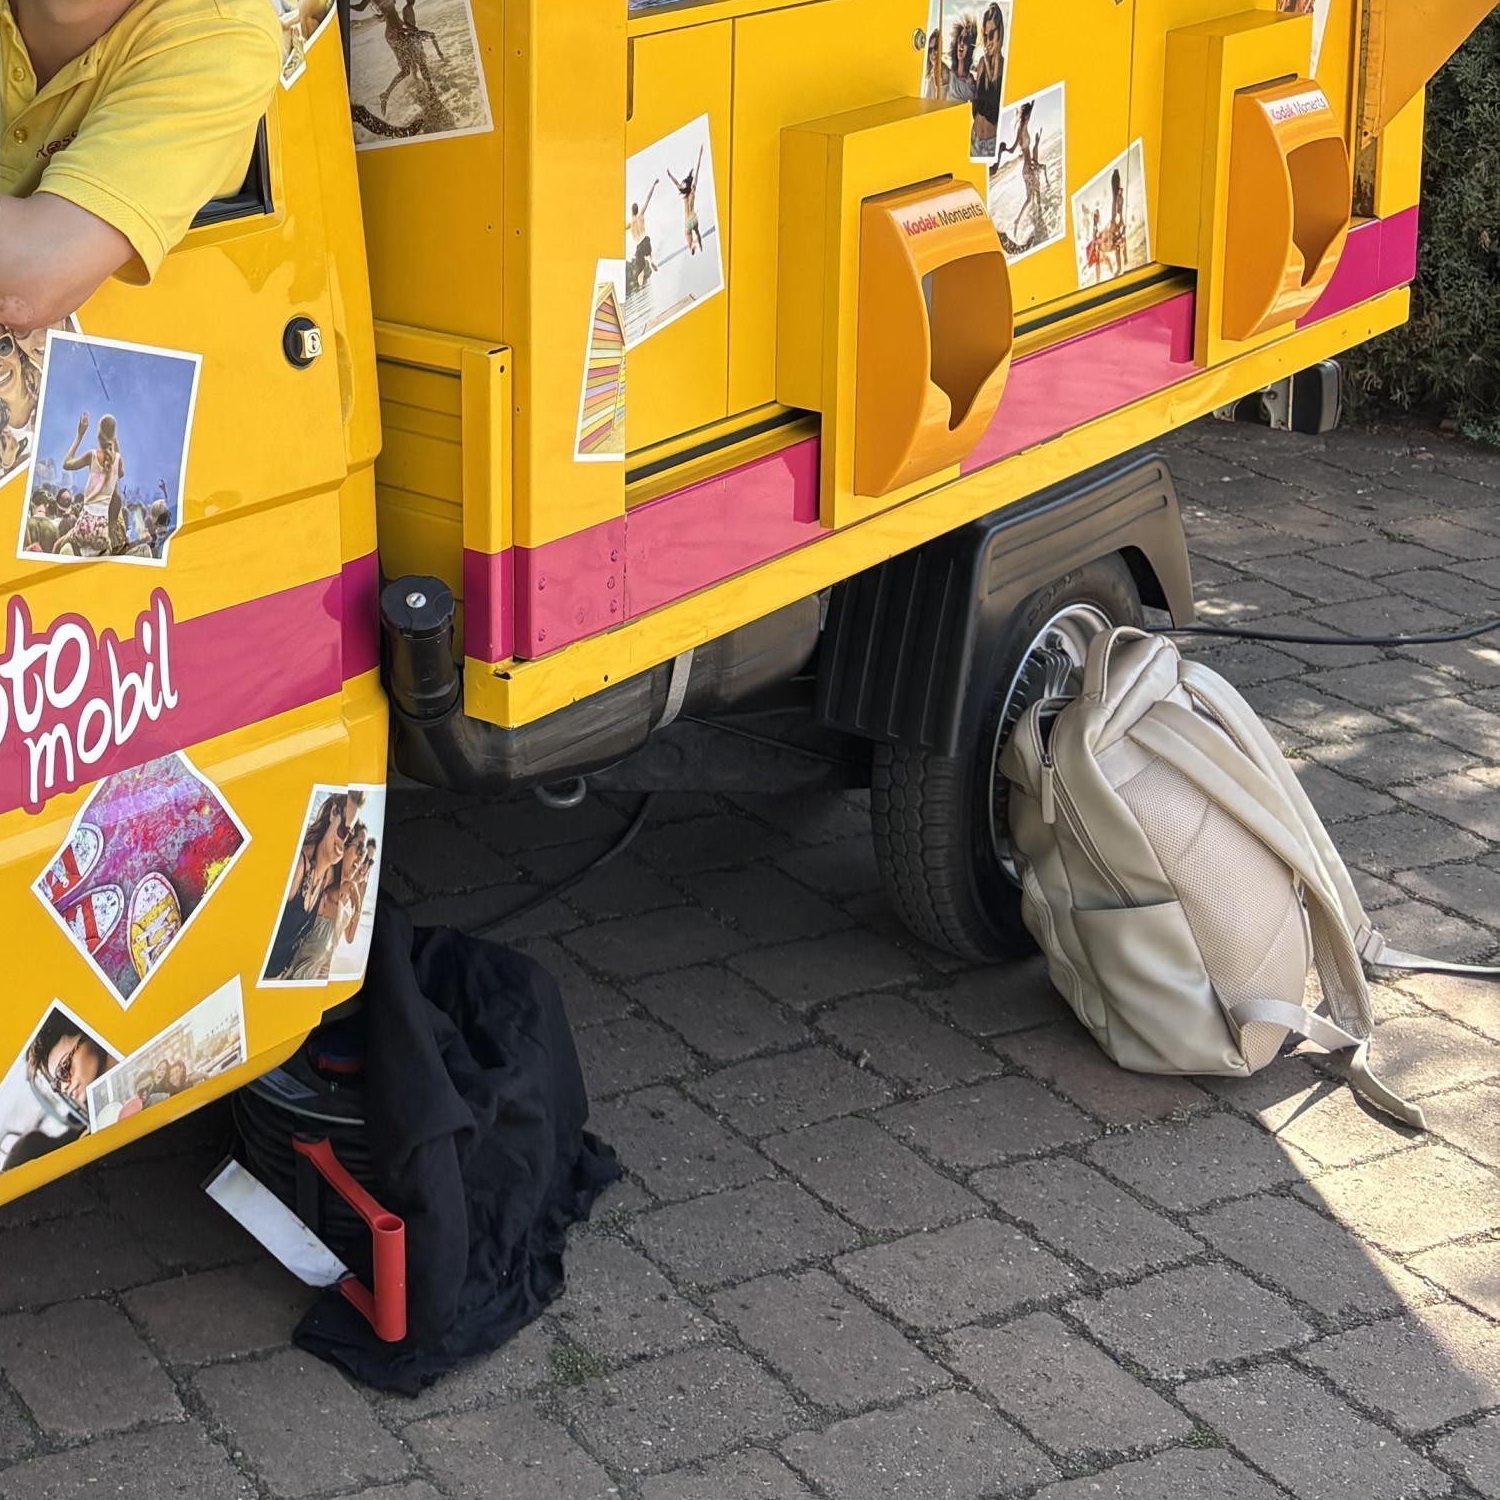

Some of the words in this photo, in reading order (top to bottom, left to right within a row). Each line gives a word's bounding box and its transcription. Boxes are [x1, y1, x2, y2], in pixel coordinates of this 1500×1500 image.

[903, 213, 940, 237] Kodak
[937, 202, 984, 227] Moments
[23, 597, 179, 804] mobil
